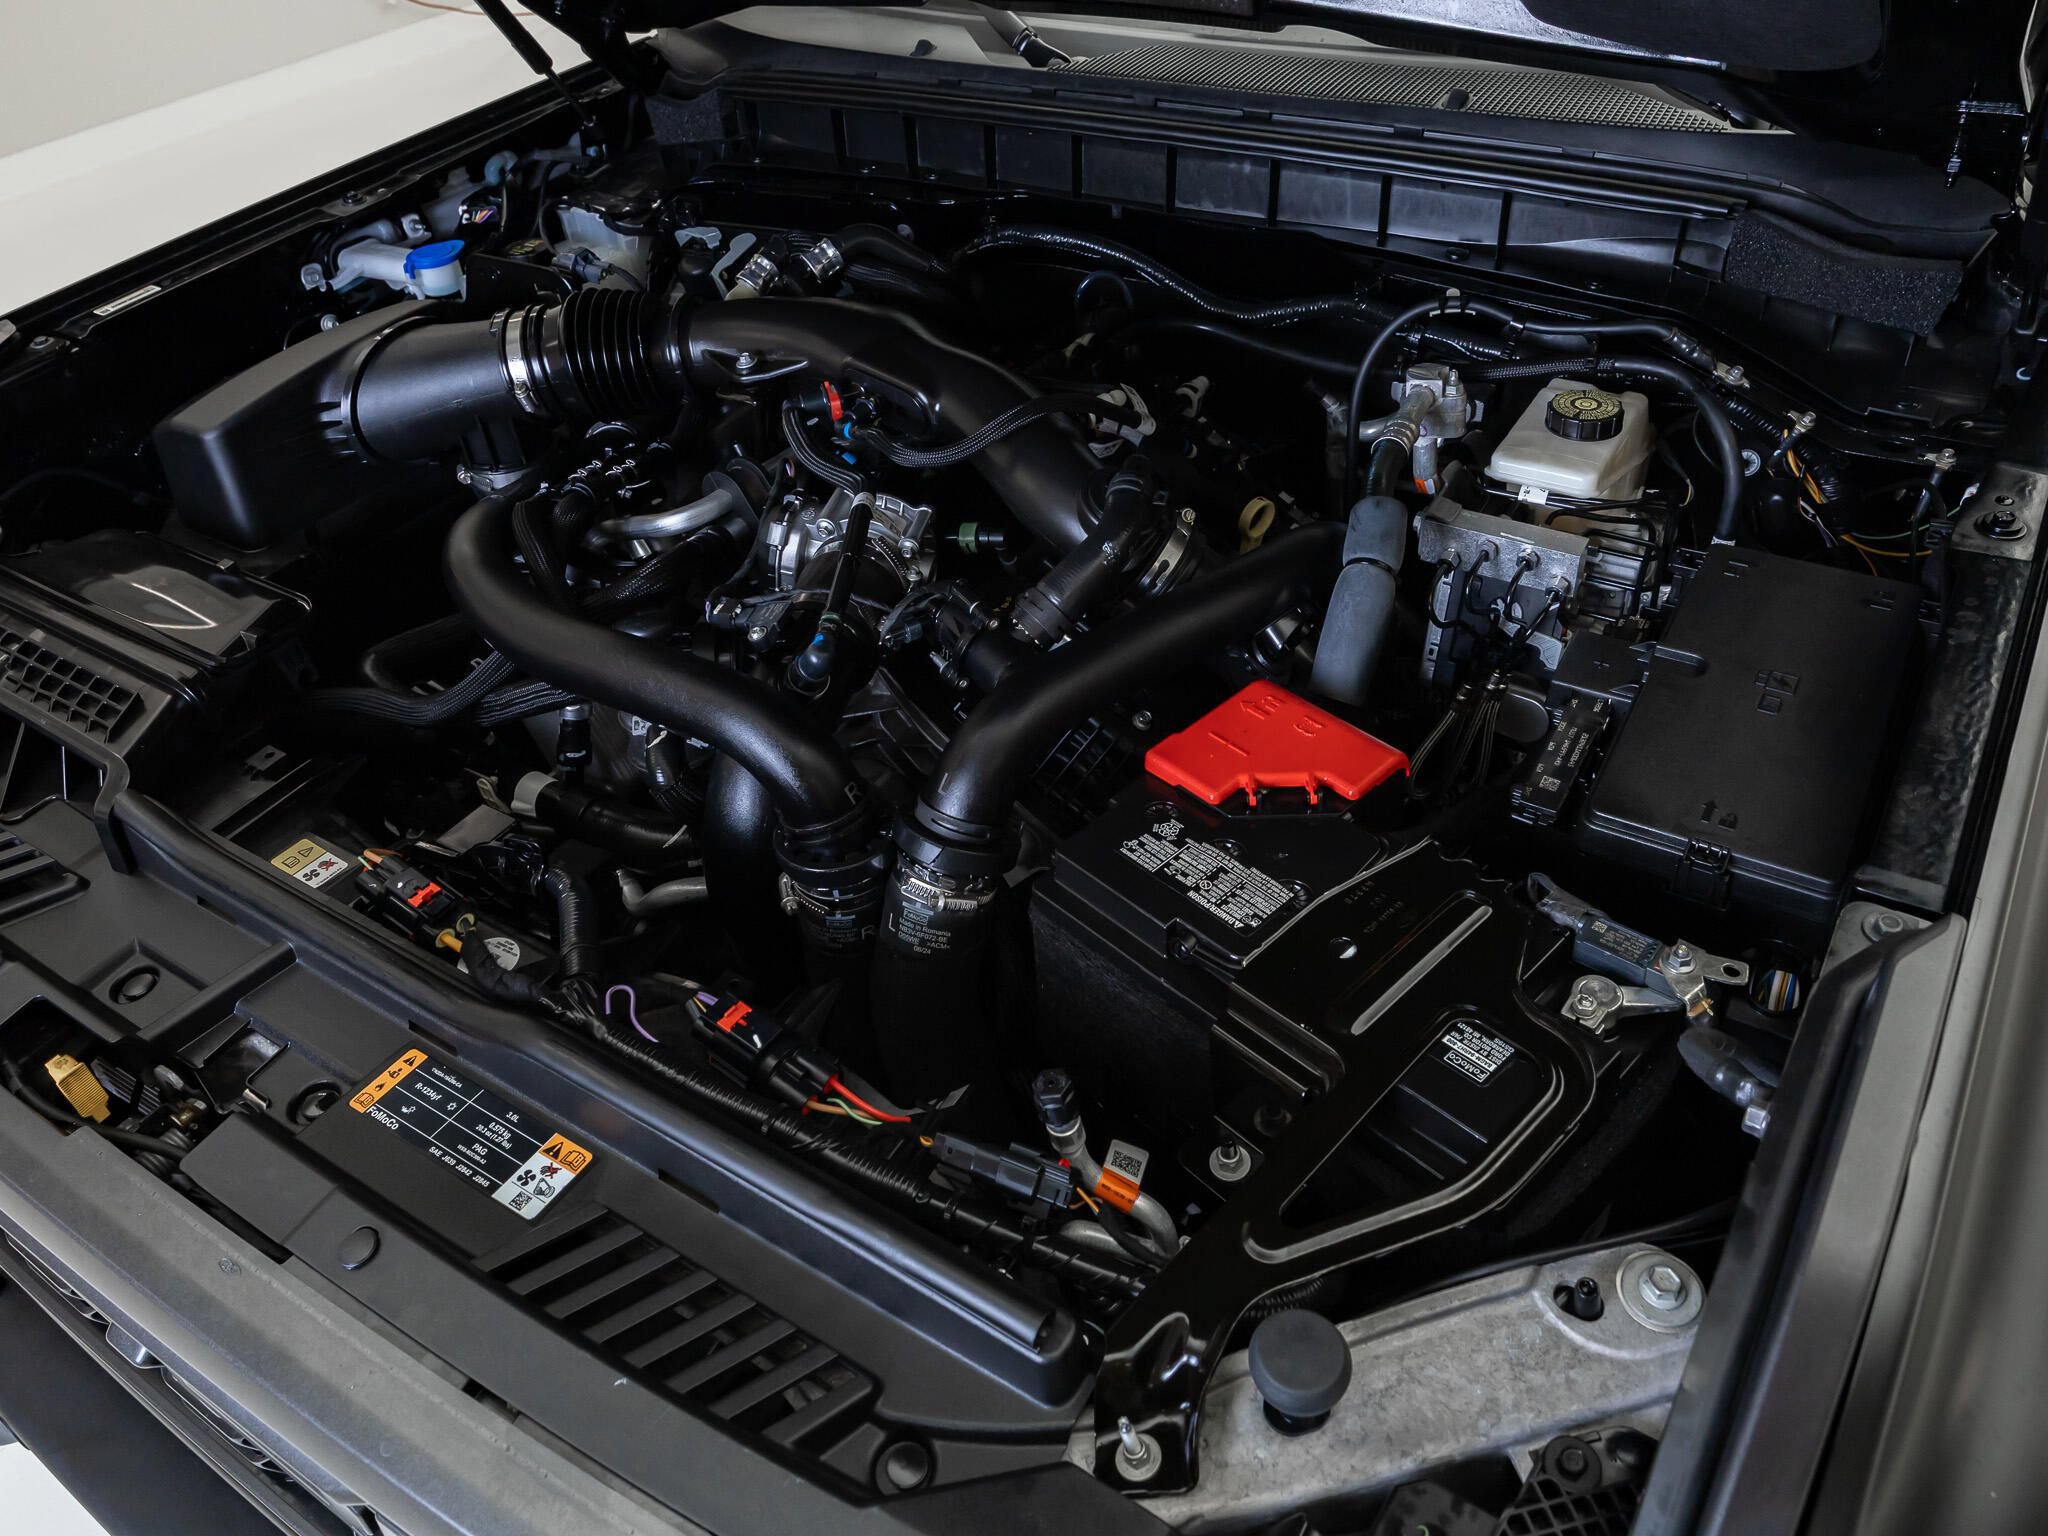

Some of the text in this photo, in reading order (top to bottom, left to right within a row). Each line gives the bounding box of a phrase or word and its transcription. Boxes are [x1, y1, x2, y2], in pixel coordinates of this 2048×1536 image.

[844, 782, 862, 805] R
[1187, 890, 1236, 926] DANGER/POISON
[888, 912, 896, 932] L
[899, 918, 914, 928] Made
[922, 926, 950, 936] Romania
[1472, 1038, 1491, 1051] MOTOR
[1449, 1053, 1486, 1078] FoMoCo
[1490, 1050, 1506, 1061] FORD
[414, 1082, 442, 1102] R-1234yf
[367, 1106, 399, 1130] FoMoCo
[506, 1112, 519, 1123] 3.0L
[488, 1122, 512, 1140] 0.575 kg
[471, 1143, 488, 1156] PAG
[429, 1146, 490, 1188] SAE J639 J2842 J2845
